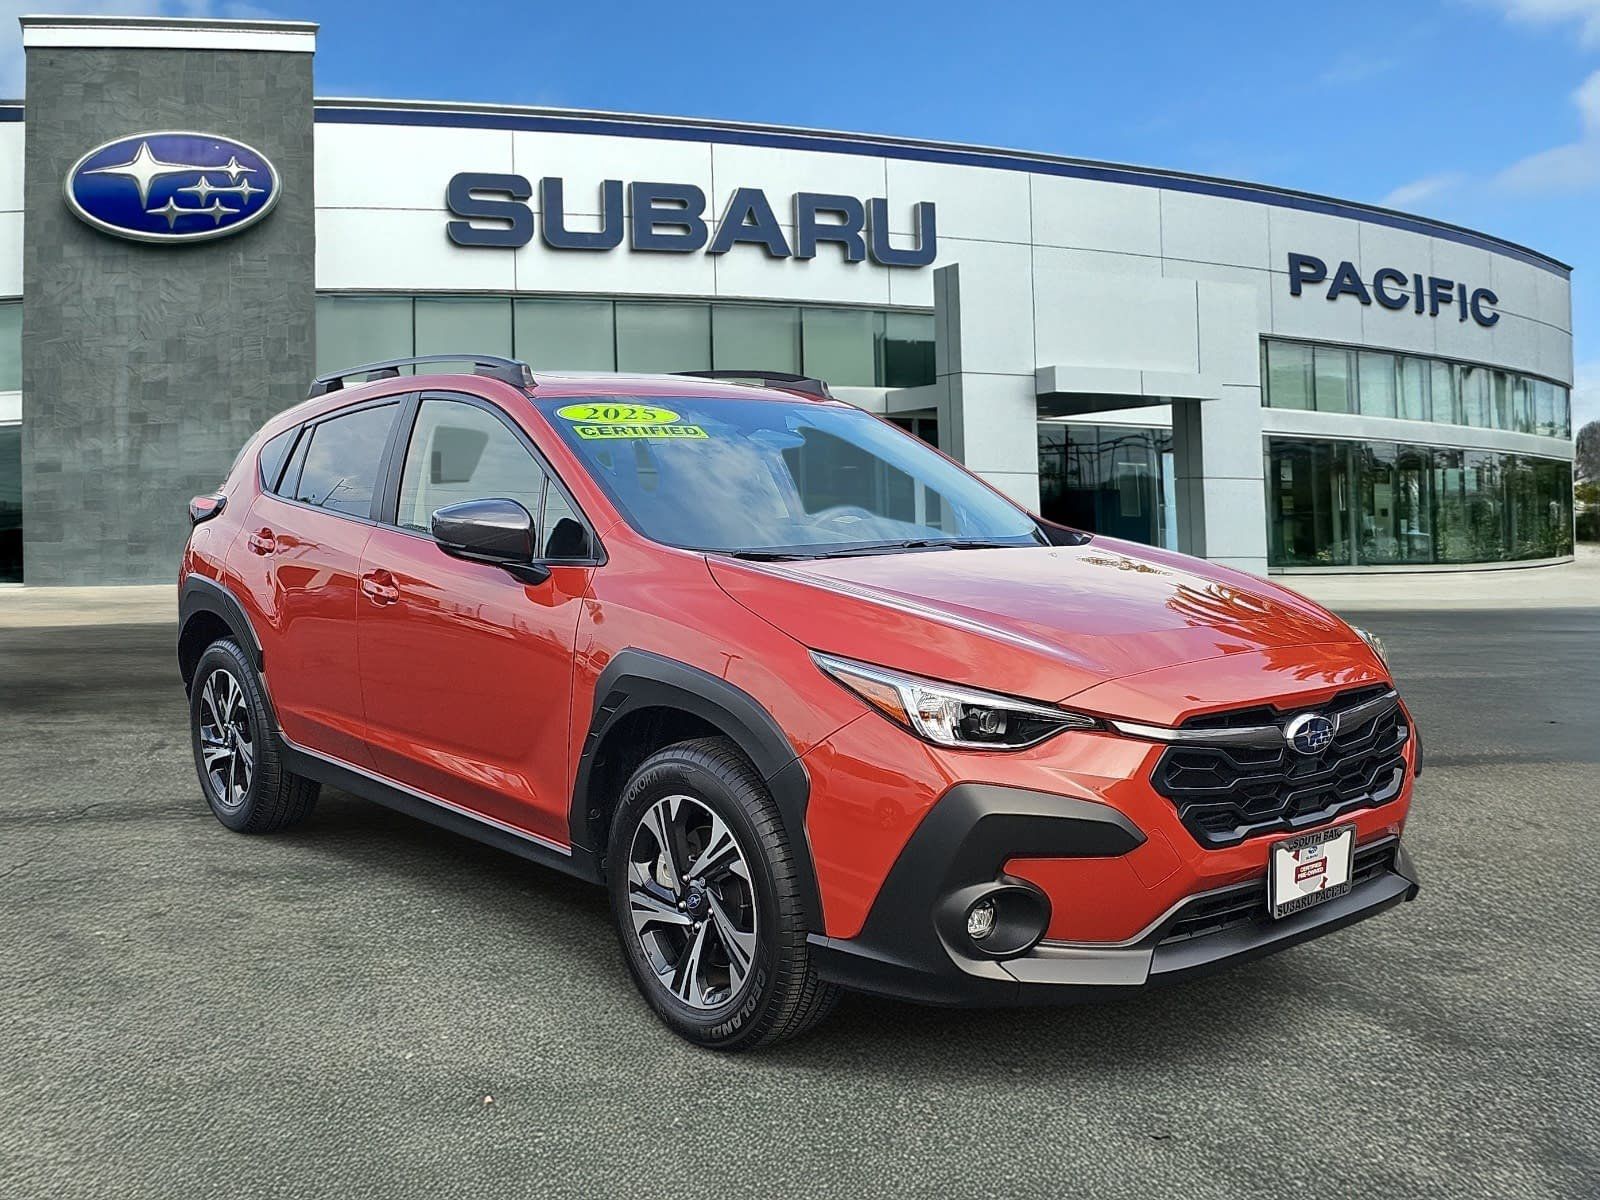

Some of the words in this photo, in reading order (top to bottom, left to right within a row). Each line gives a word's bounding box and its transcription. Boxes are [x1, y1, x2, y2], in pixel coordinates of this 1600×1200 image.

[446, 171, 937, 268] SUBARU
[1288, 252, 1500, 328] PACIFIC
[585, 407, 657, 420] 2025
[580, 426, 699, 436] CERTIFIED
[1293, 832, 1322, 849] SOUTH
[1277, 895, 1314, 917] SUBARU
[1315, 883, 1349, 902] PACIFIC
